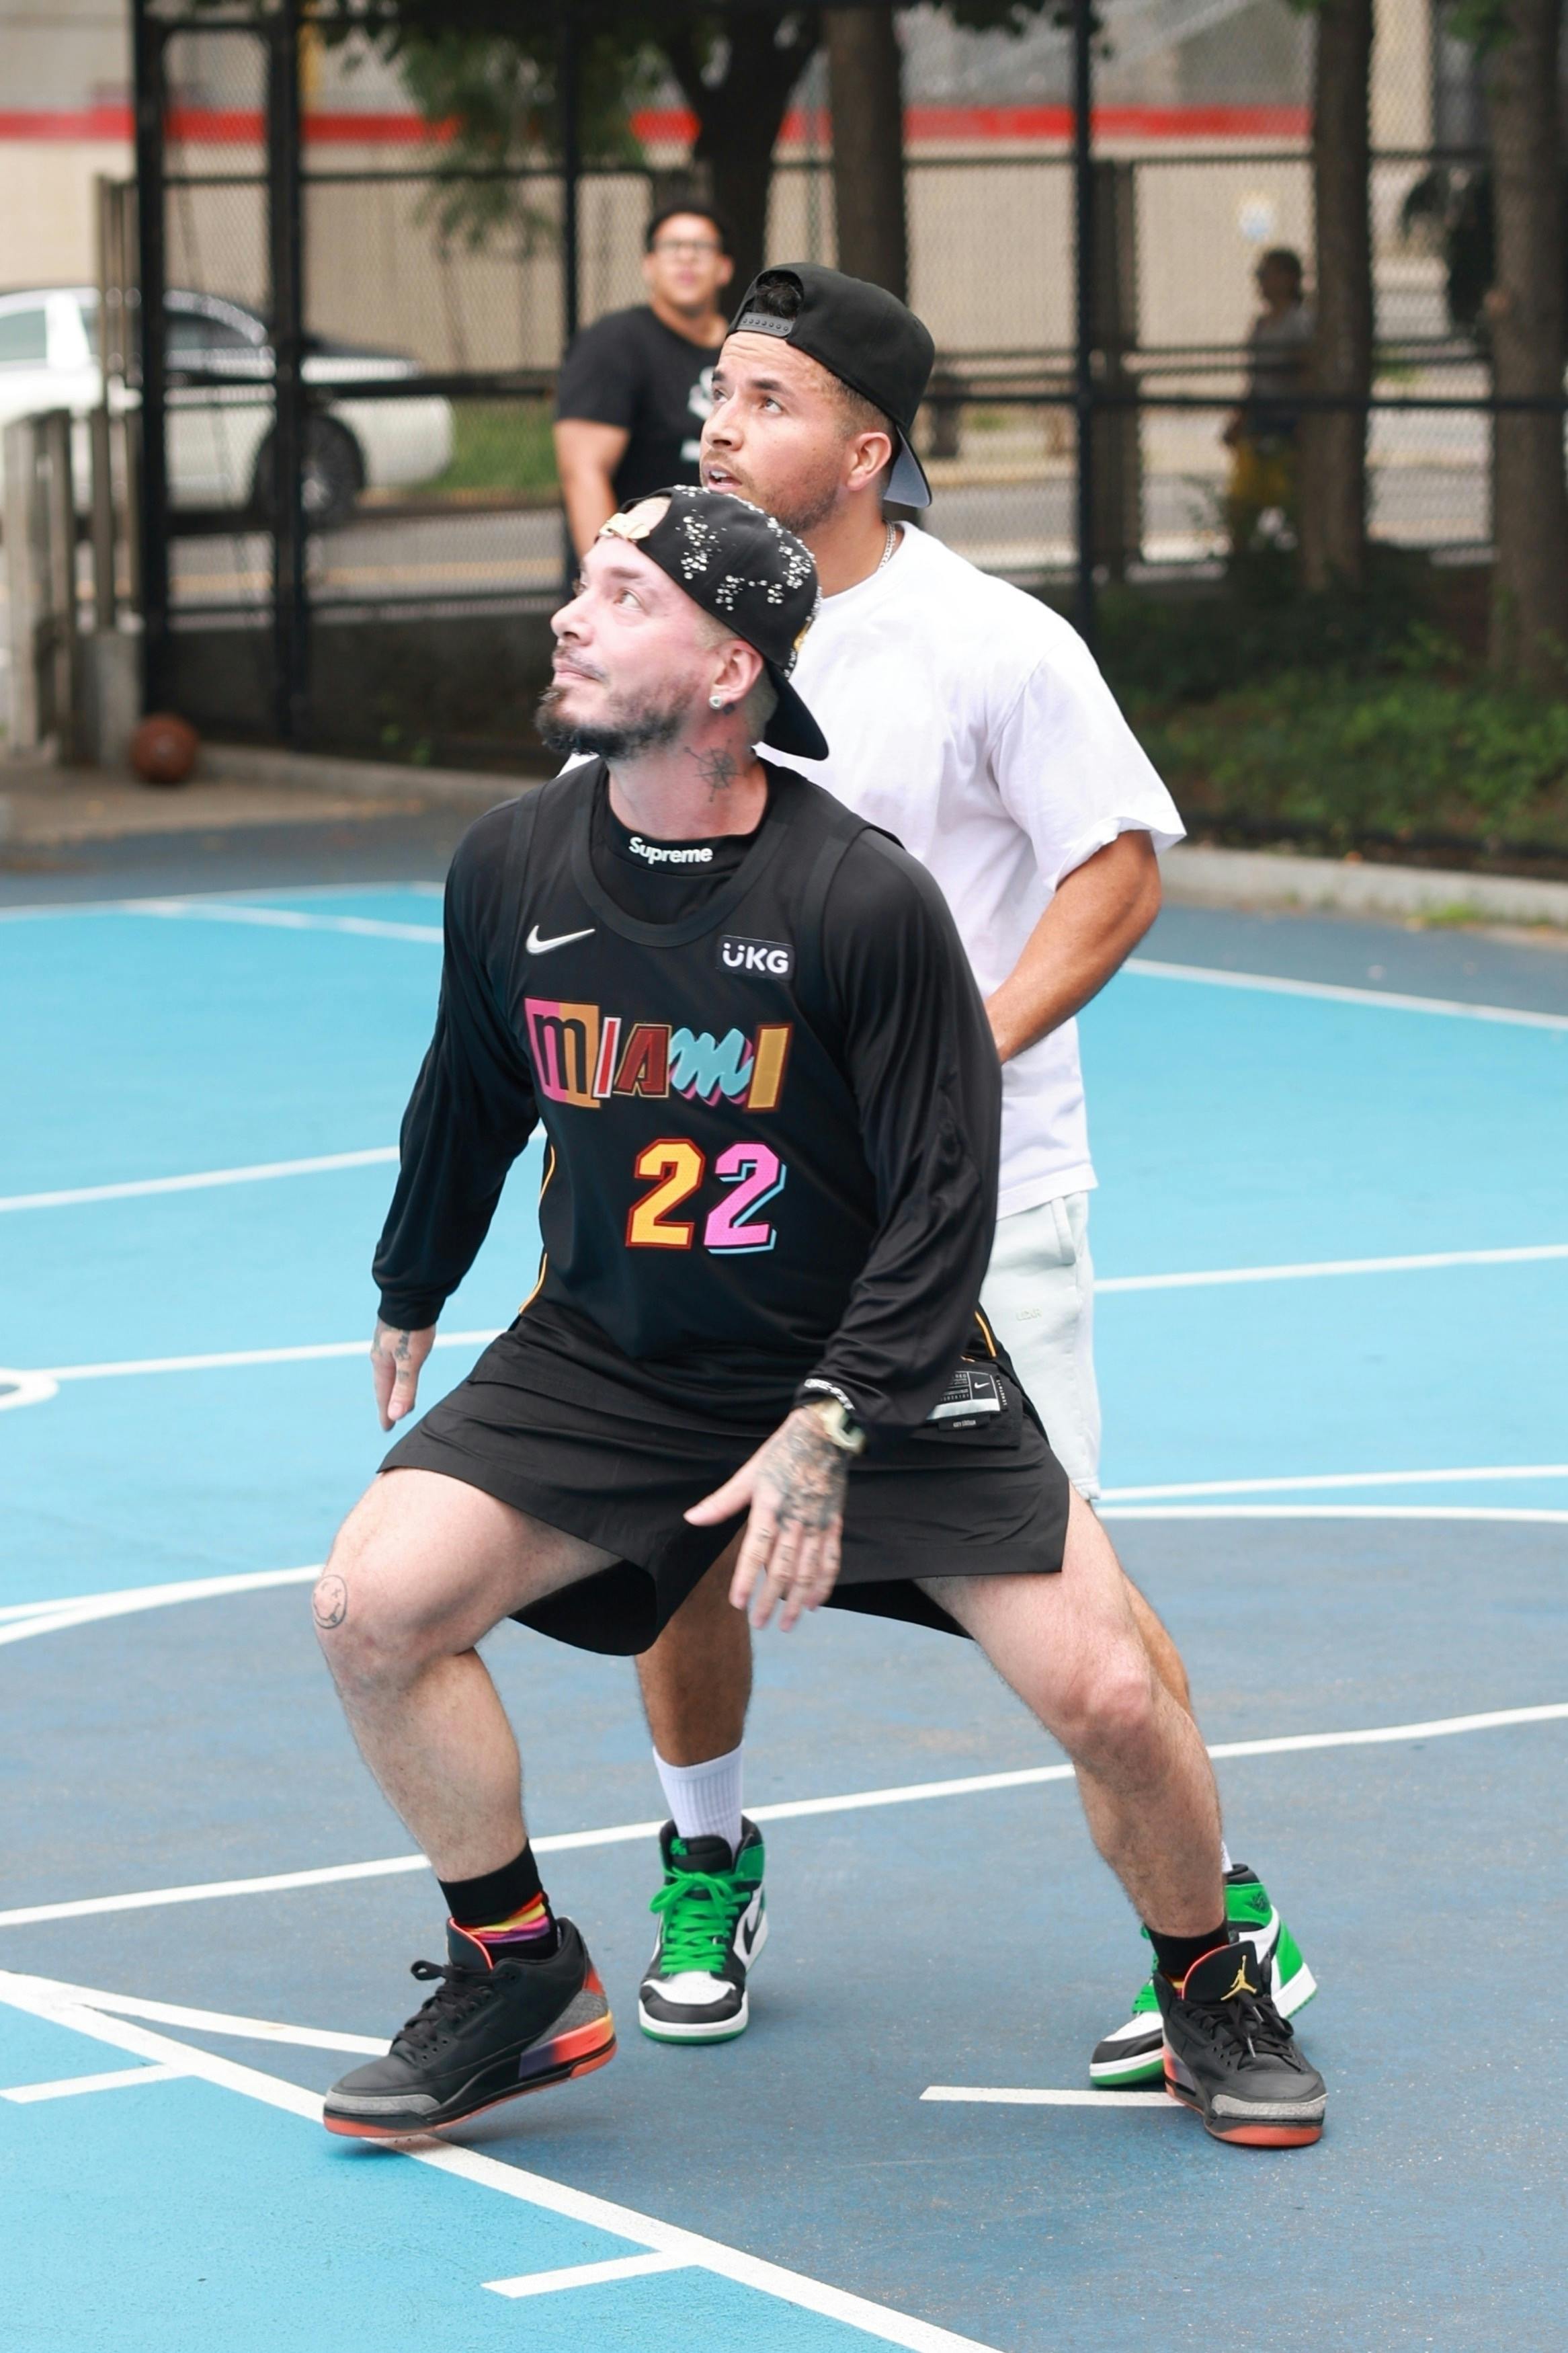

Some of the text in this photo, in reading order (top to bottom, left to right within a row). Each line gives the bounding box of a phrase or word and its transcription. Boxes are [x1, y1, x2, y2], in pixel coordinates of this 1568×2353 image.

[628, 836, 713, 865] Supreme
[524, 997, 794, 1113] MIAMI
[625, 1138, 787, 1254] 22
